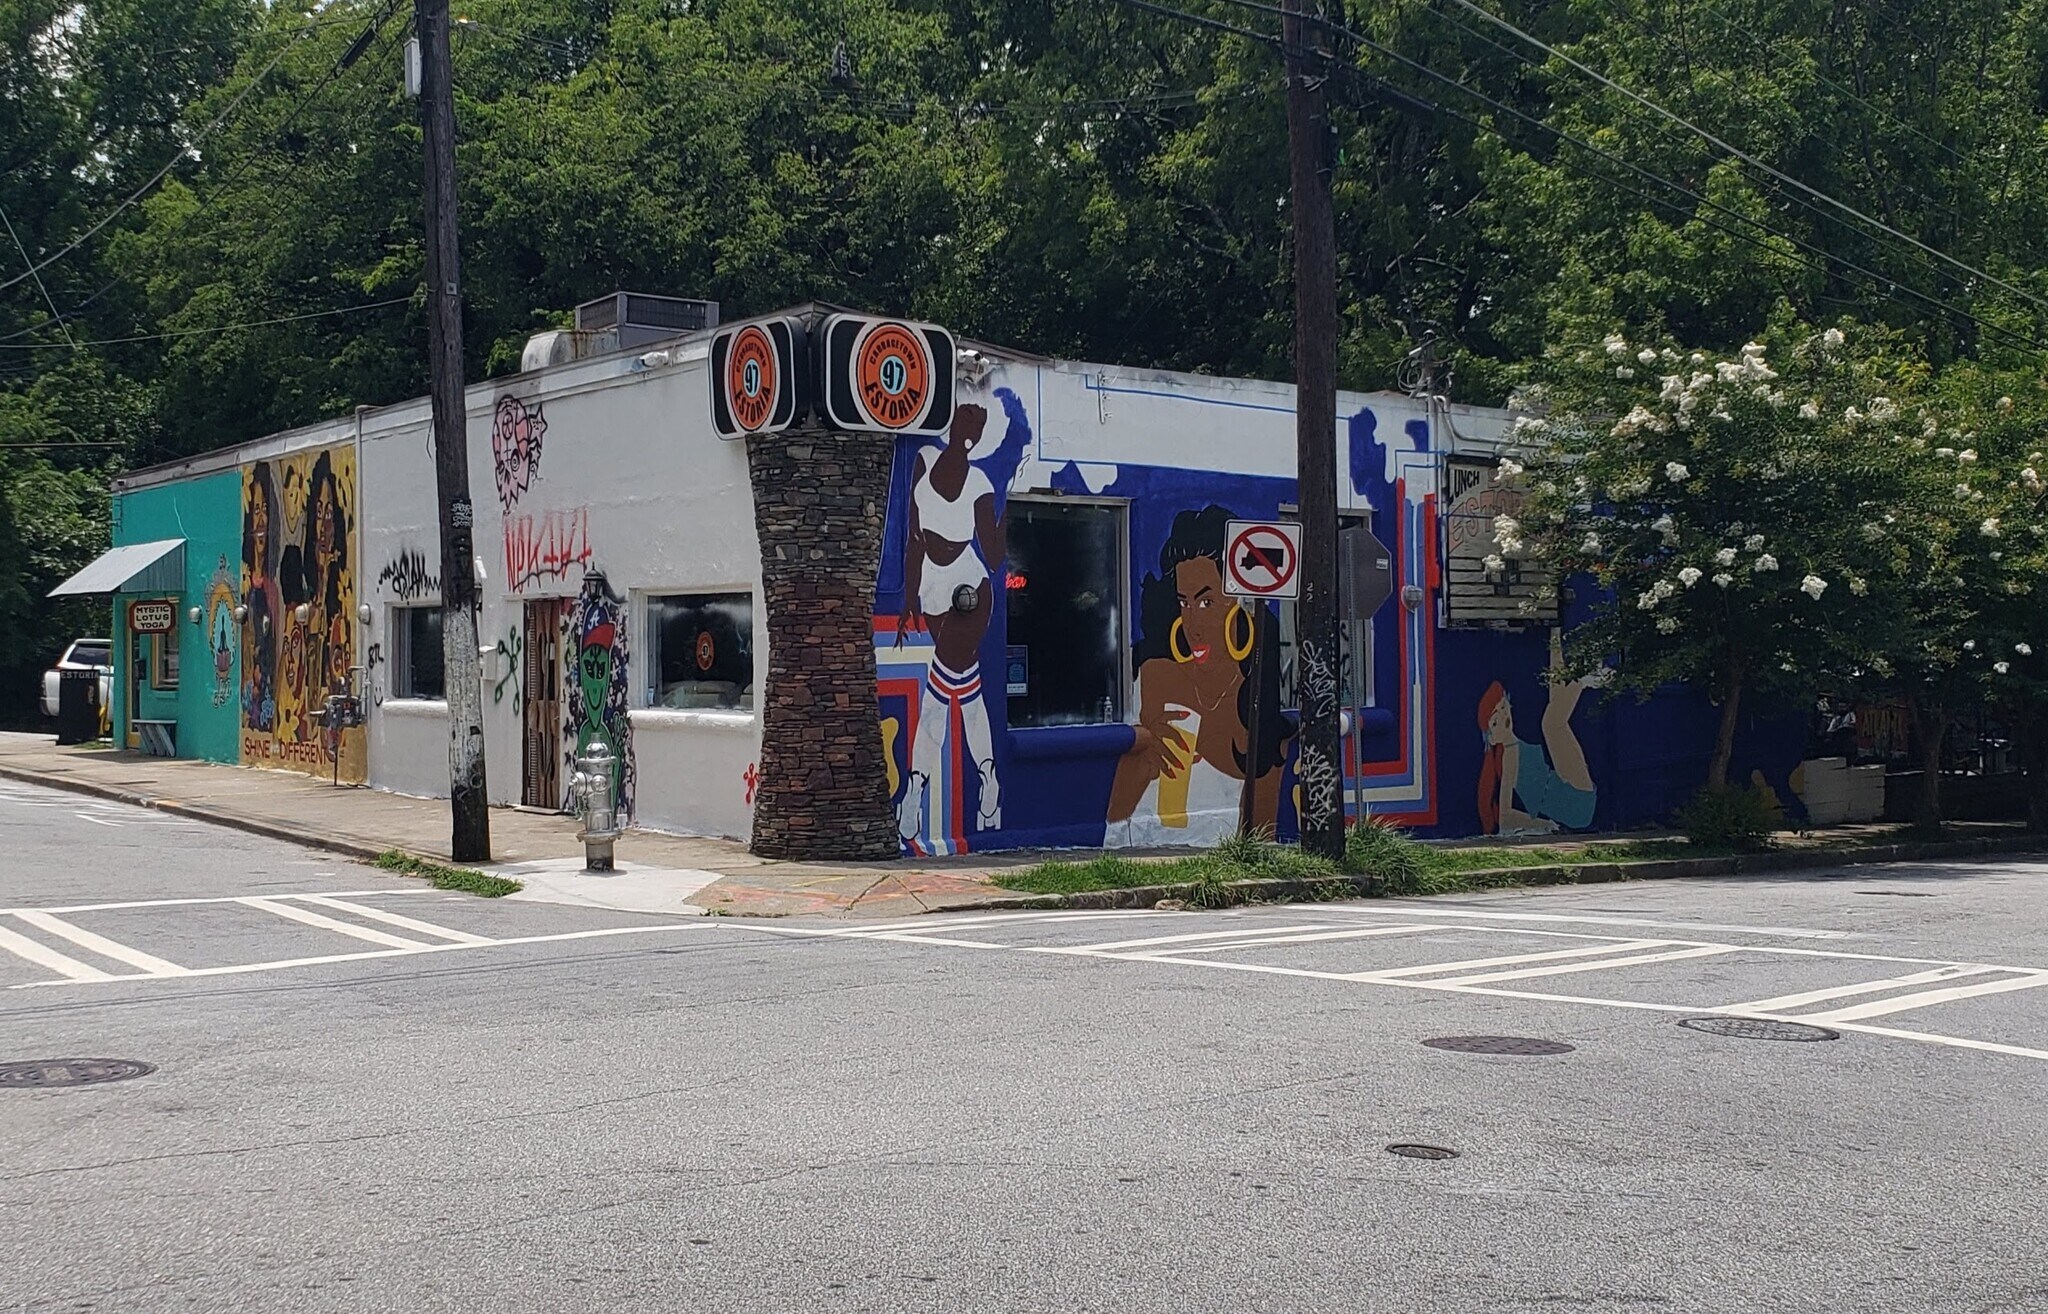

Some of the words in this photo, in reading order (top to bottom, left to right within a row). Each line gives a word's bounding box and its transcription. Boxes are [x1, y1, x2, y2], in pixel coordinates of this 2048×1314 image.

[869, 339, 917, 370] CABBAGETOWN
[745, 363, 759, 393] 97
[882, 360, 904, 392] 97
[734, 385, 771, 422] ESTORIA
[864, 382, 920, 420] ESTORIA
[136, 605, 170, 613] MYSTIC
[136, 613, 170, 622] LOTUS
[140, 621, 165, 629] YOGA
[60, 671, 99, 679] ESTORIA
[244, 737, 270, 758] SHINE
